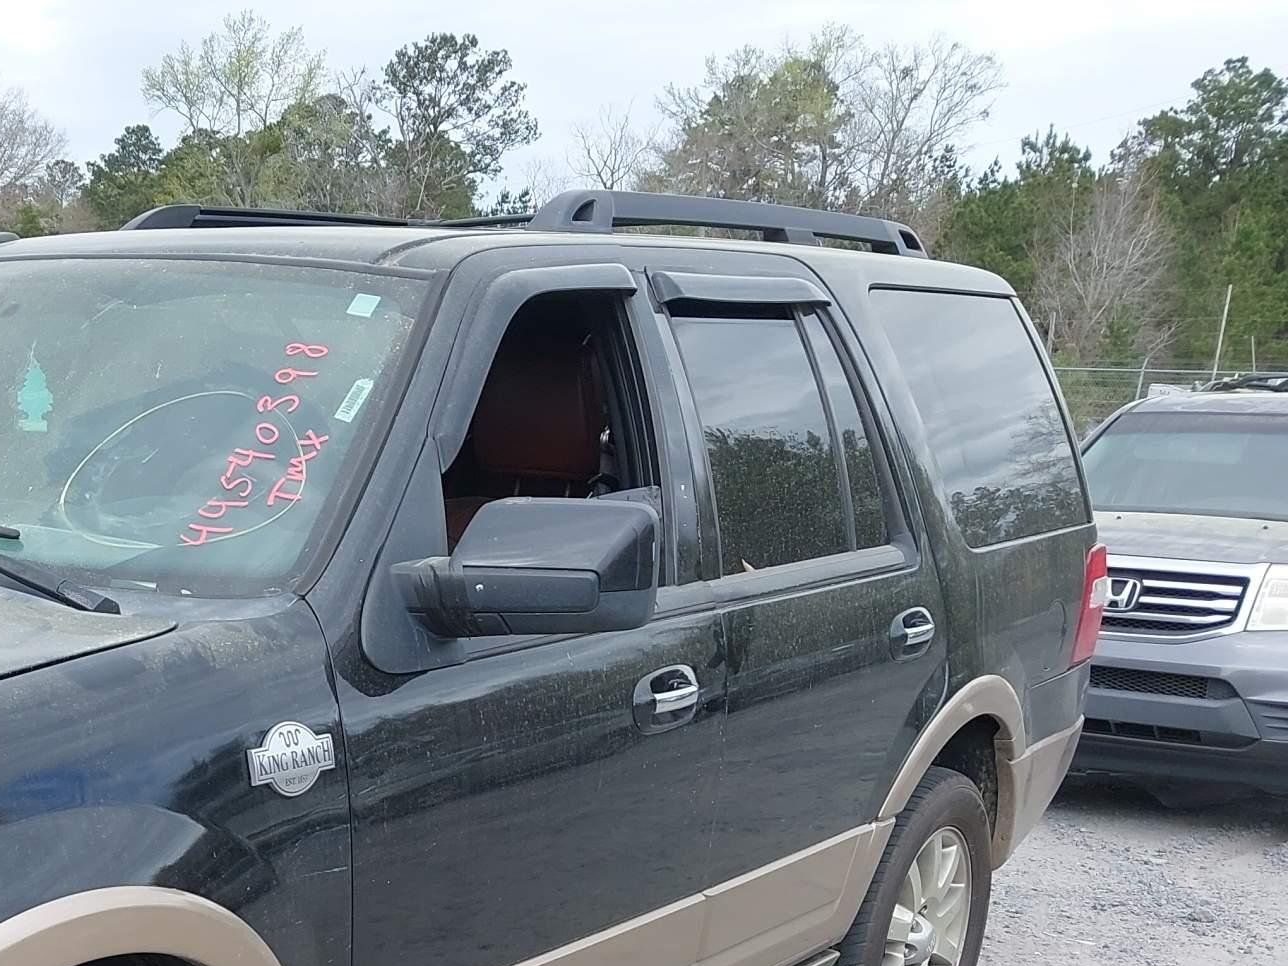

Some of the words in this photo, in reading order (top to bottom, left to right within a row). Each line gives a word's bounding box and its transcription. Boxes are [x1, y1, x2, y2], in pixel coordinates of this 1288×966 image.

[179, 342, 329, 546] 44540398
[257, 753, 289, 776] KING
[292, 741, 331, 769] RANCH
